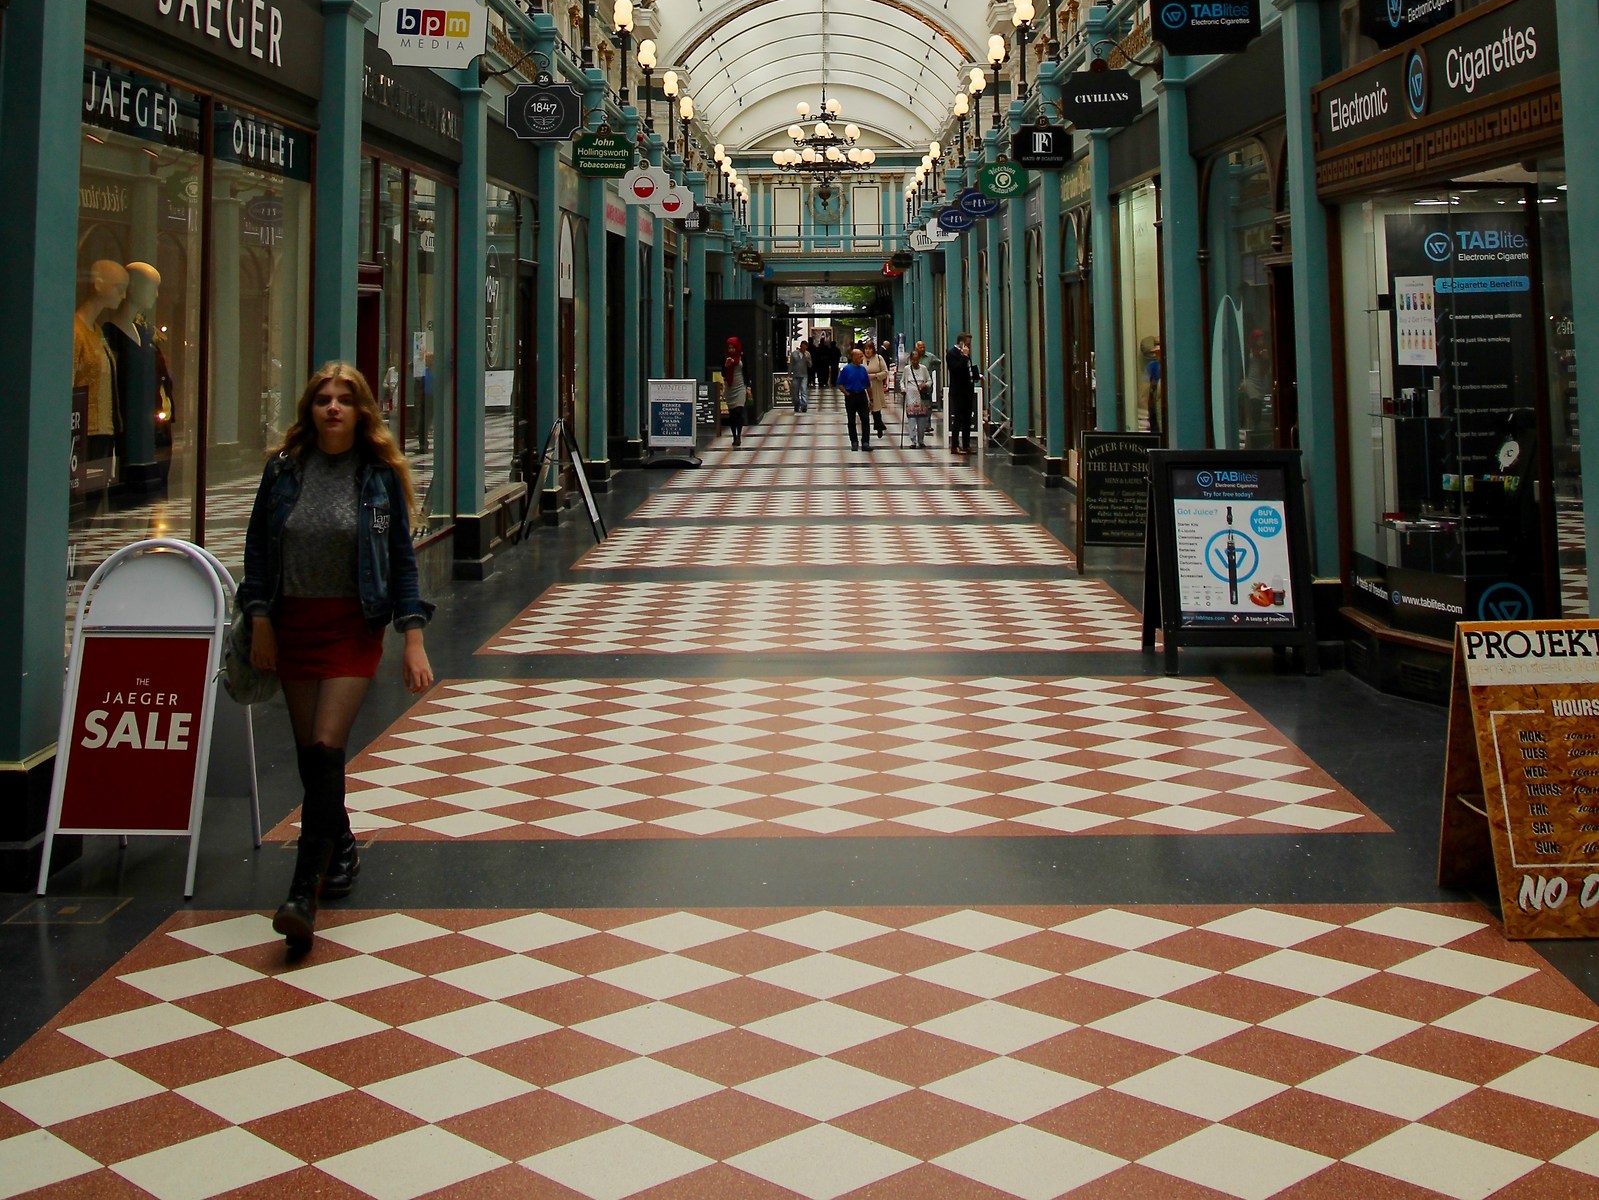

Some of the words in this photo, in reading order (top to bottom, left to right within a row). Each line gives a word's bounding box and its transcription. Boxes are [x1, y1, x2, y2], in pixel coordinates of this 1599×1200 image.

[1190, 2, 1249, 18] TABlites
[399, 10, 469, 36] bpm
[1191, 18, 1219, 27] Electronic
[1220, 17, 1250, 27] Cigarettes
[400, 38, 465, 50] MEDIA
[1446, 26, 1537, 93] Cigarettes
[539, 74, 549, 83] 26
[86, 71, 178, 136] JAEGER
[1075, 92, 1129, 104] CIVILIANS
[531, 102, 557, 115] 1847
[1330, 81, 1388, 132] Electronic
[232, 119, 294, 168] OUTLET
[592, 138, 615, 146] John
[577, 148, 629, 158] Hollingsworth
[579, 160, 626, 169] Tobacconists
[1458, 253, 1495, 262] Electronic
[1489, 280, 1523, 289] Benefits
[1088, 441, 1117, 459] PETER
[1087, 462, 1107, 472] THE
[1109, 462, 1130, 472] HAT
[1214, 471, 1258, 482] TABlites
[1193, 508, 1218, 516] Juice?
[1402, 595, 1463, 614] www.tablites.com
[135, 677, 151, 687] THE
[102, 691, 178, 706] JAEGER
[1551, 699, 1599, 717] HOURS
[81, 711, 192, 751] SALE
[1519, 730, 1545, 743] MON:
[1520, 747, 1548, 760] TUES:
[1523, 765, 1548, 779] WED:
[1526, 783, 1562, 797] THURS:
[1529, 803, 1549, 816] FRI:
[1532, 821, 1554, 834] SAT:
[1535, 841, 1560, 854] SUN:
[1518, 874, 1569, 913] NO
